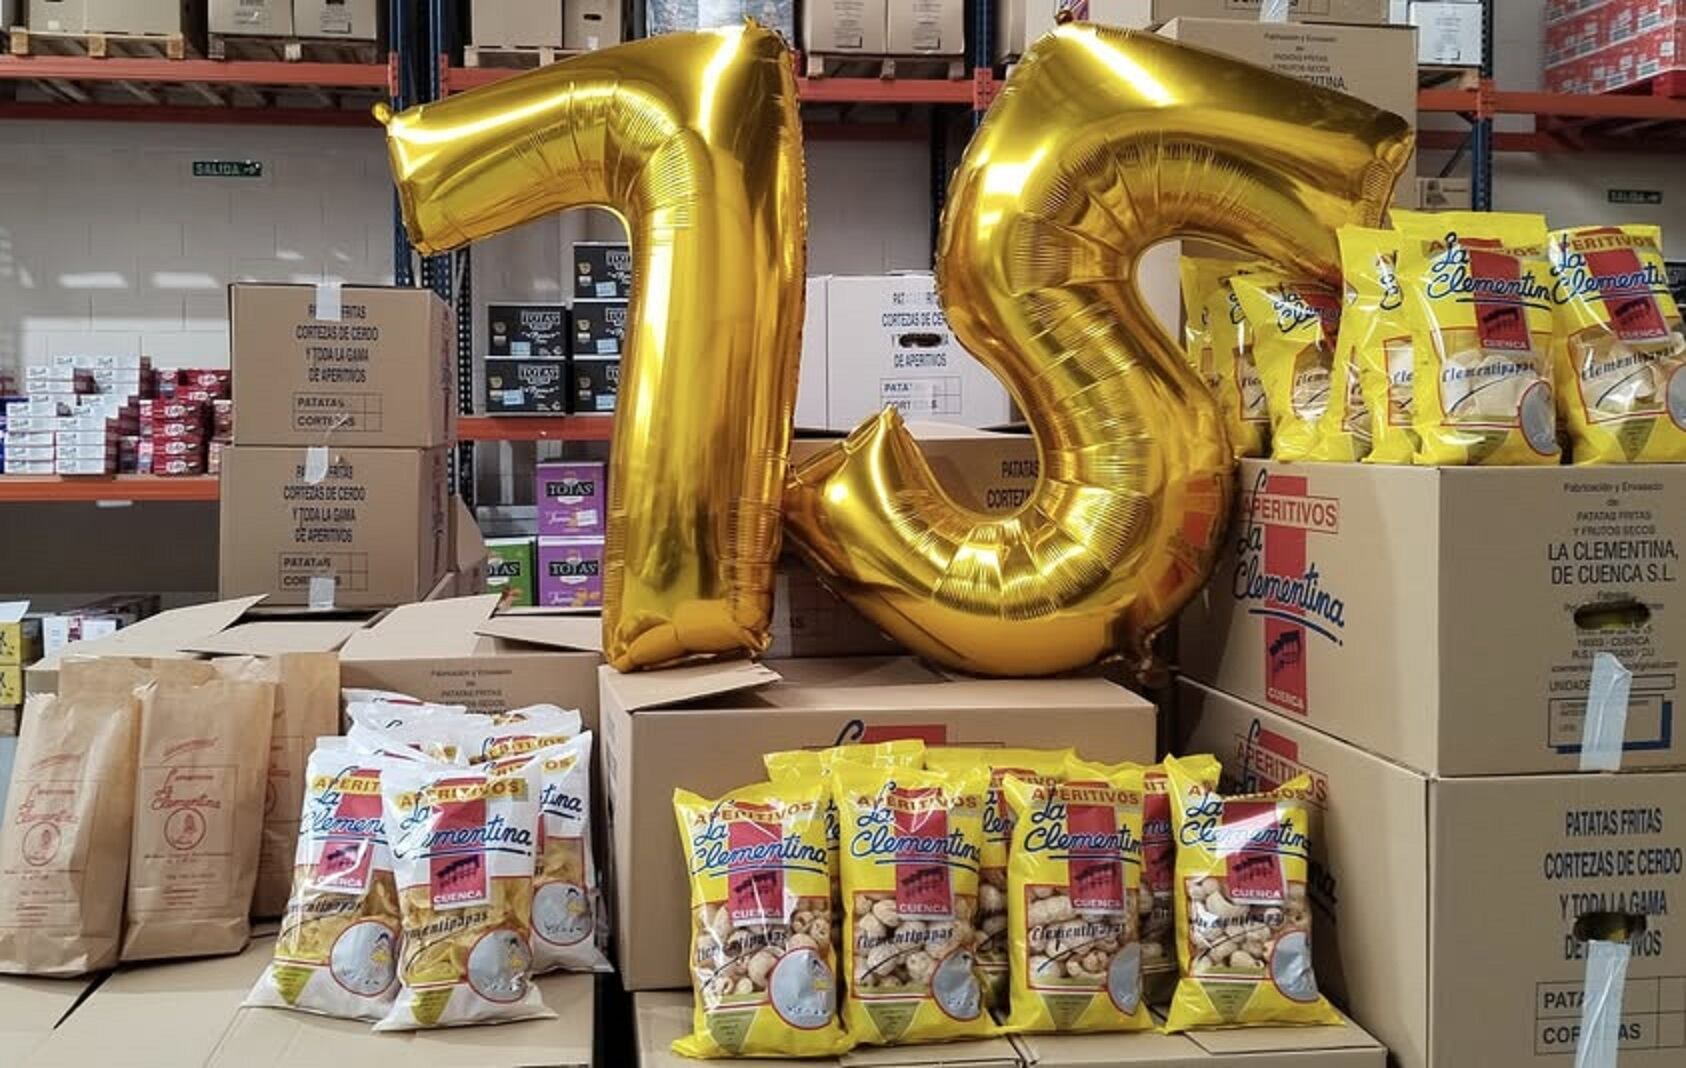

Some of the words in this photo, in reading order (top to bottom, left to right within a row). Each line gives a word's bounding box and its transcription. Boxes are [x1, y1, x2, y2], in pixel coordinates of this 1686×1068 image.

[195, 163, 240, 175] SALIDA
[1432, 231, 1470, 272] La
[1427, 267, 1550, 300] Clementin
[881, 312, 920, 328] CORTEZAS
[920, 312, 932, 327] DE
[296, 325, 338, 341] CORTEZAS
[339, 326, 350, 341] DE
[351, 326, 379, 342] CERDO
[1619, 328, 1665, 340] CUENCA
[1482, 338, 1529, 351] CUENCA
[305, 347, 311, 362] Y
[313, 347, 334, 362] TODA
[335, 348, 347, 362] LA
[348, 348, 369, 362] GAMA
[893, 354, 905, 369] DE
[905, 353, 948, 368] APERITIVOS
[308, 368, 320, 382] DE
[321, 368, 367, 383] APERITIVOS
[297, 397, 345, 408] PATATAS
[283, 485, 326, 501] CORTEZAS
[326, 486, 337, 501] DE
[338, 486, 367, 502] CERDO
[550, 482, 593, 495] TOTAS
[292, 507, 298, 522] Y
[299, 507, 321, 522] TODA
[321, 507, 333, 522] LA
[333, 508, 356, 522] GAMA
[1236, 468, 1268, 554] La
[1246, 497, 1338, 528] APERITIVOS
[1576, 511, 1617, 521] PATATAS
[1618, 510, 1652, 520] FRITAS
[294, 528, 306, 543] DE
[307, 528, 353, 543] APERITIVOS
[1573, 527, 1579, 536] Y
[1582, 526, 1621, 536] FRUTOS
[1623, 524, 1656, 535] SECOS
[1548, 543, 1569, 561] LA
[283, 557, 332, 568] PATATAS
[551, 562, 598, 576] TOTAS
[1552, 565, 1573, 585] DE
[1578, 564, 1643, 585] CUENCA
[1232, 555, 1346, 629] Clementina
[1549, 679, 1591, 692] UNIDADE
[1267, 687, 1305, 709] CUENCA
[1031, 787, 1139, 805] APERITIVOS
[1185, 790, 1223, 818] La
[856, 781, 897, 828] La
[1031, 785, 1067, 824] La
[693, 800, 735, 846] La
[1566, 810, 1618, 837] PATATAS
[1621, 807, 1662, 835] FRITAS
[1023, 822, 1142, 852] Clementin
[1544, 851, 1615, 880] CORTEZAS
[1617, 850, 1636, 876] DE
[1637, 847, 1684, 875] CERDO
[433, 889, 483, 905] CUENCA
[1231, 888, 1282, 899] CUENCA
[899, 902, 949, 913] CUENCA
[1073, 898, 1122, 908] CUENCA
[1559, 893, 1570, 921] Y
[1629, 888, 1668, 916] GAMA
[1565, 934, 1582, 962] DE
